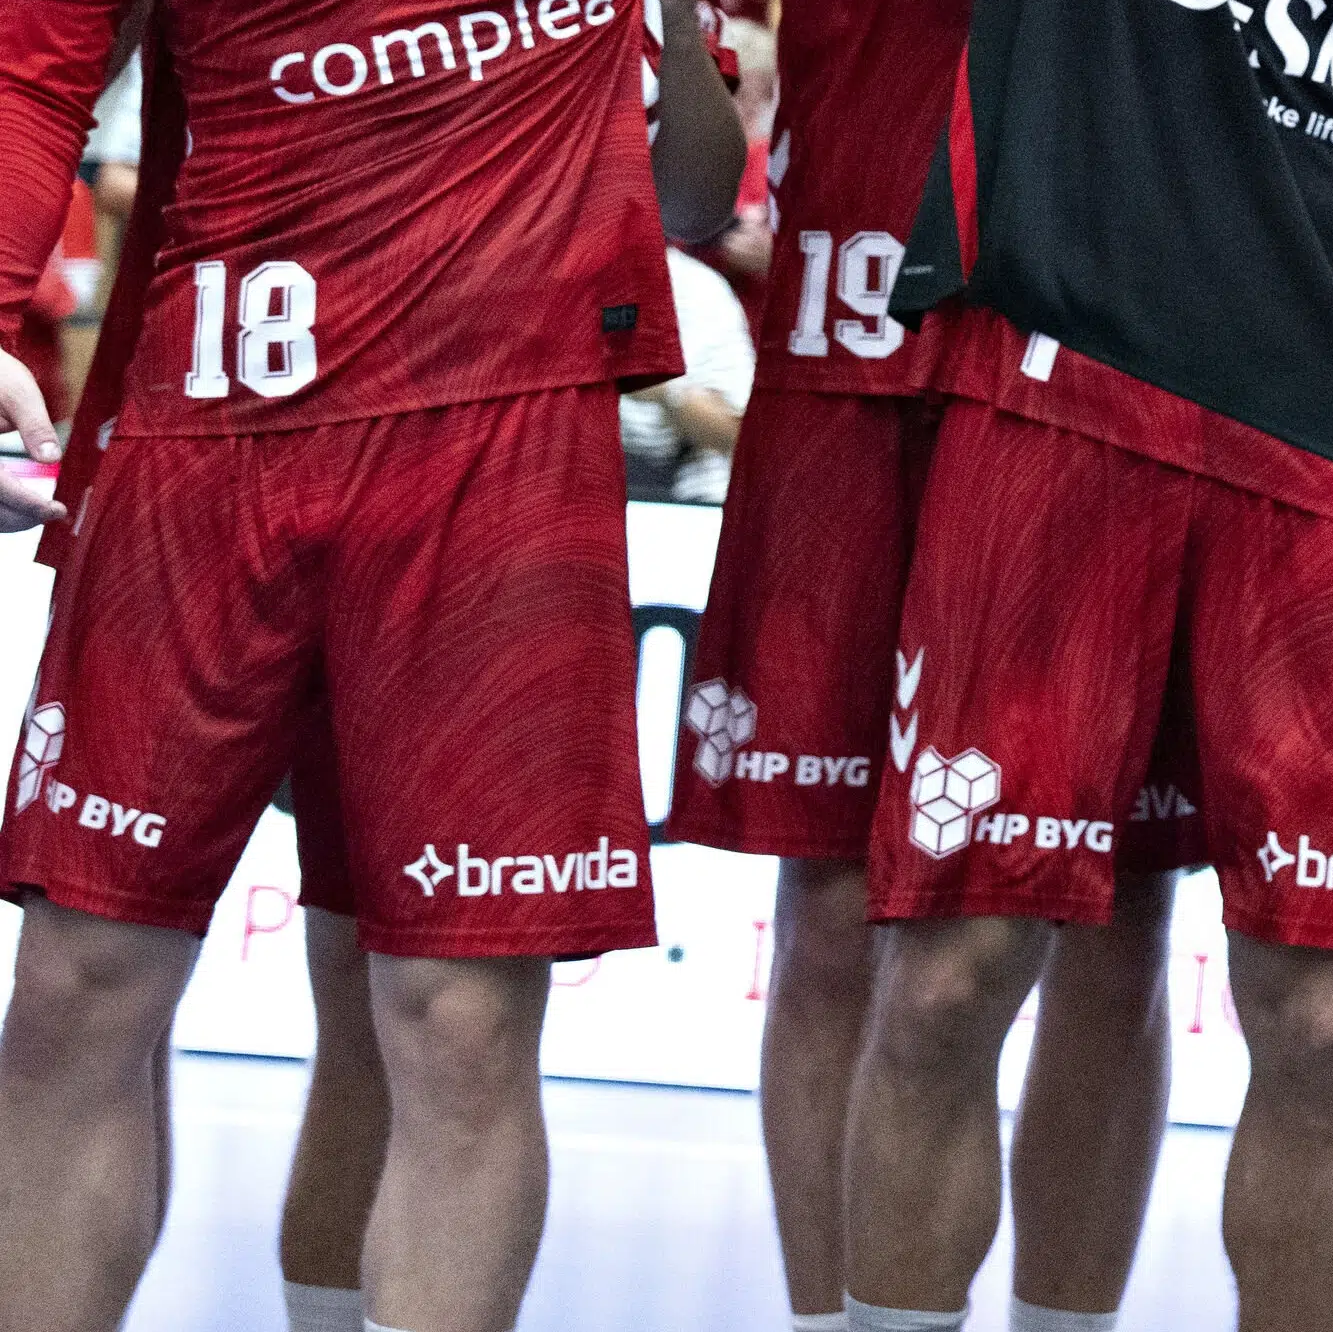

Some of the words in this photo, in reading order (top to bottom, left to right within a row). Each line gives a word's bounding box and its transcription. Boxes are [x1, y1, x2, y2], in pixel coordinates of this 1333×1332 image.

[1263, 95, 1301, 129] ke
[788, 230, 906, 359] 19
[184, 260, 318, 398] 18
[734, 751, 789, 783] HP
[794, 755, 870, 787] BYG
[78, 794, 168, 848] BYG
[975, 813, 1029, 846] HP
[1035, 816, 1115, 853] BYG
[457, 835, 639, 898] bravida
